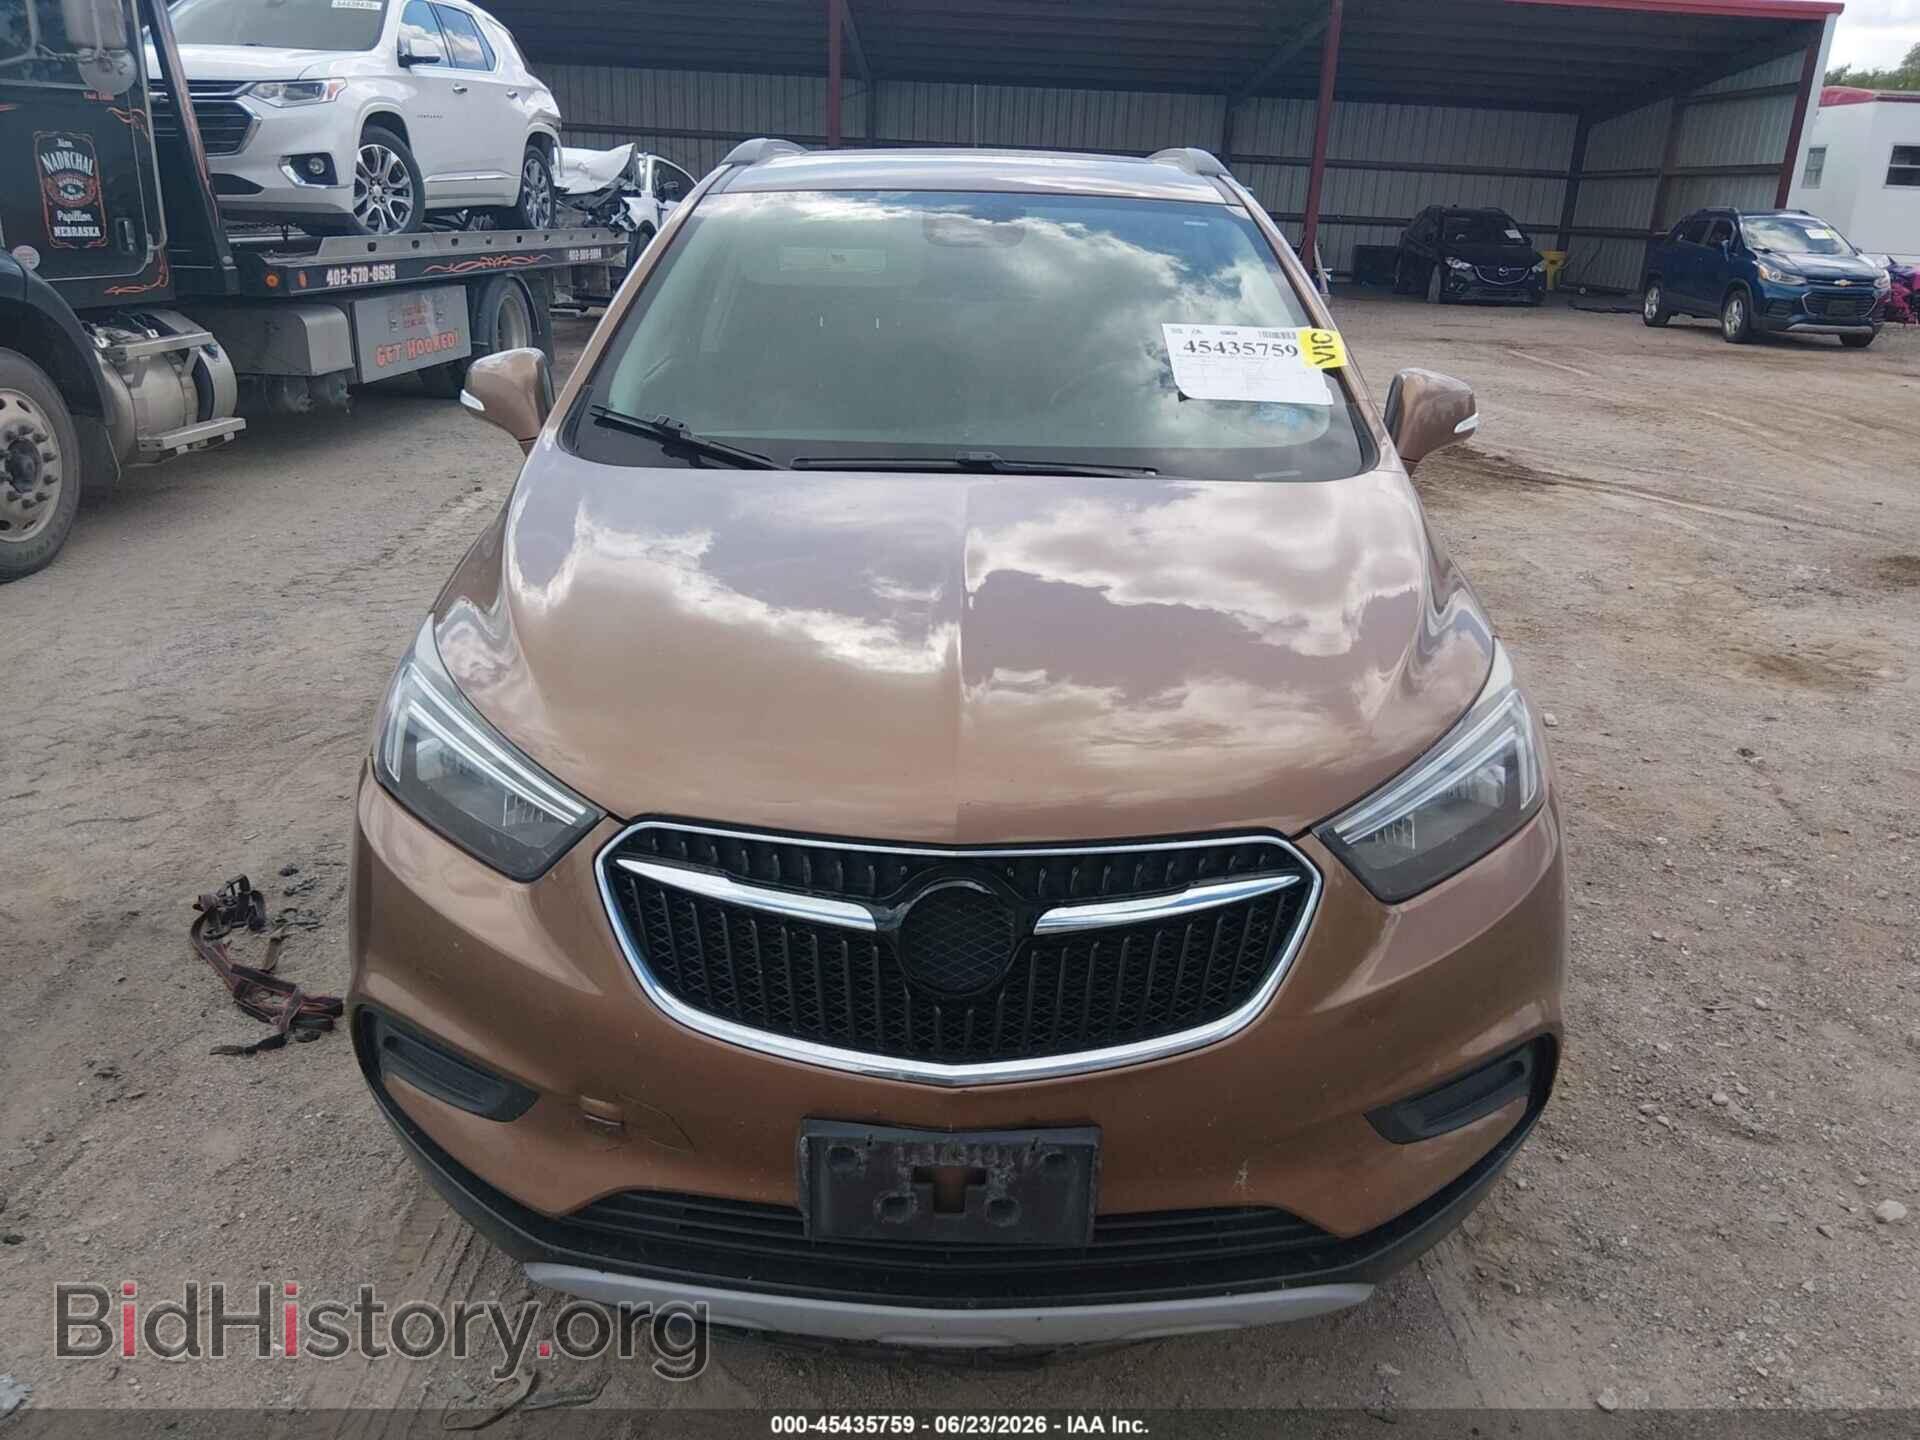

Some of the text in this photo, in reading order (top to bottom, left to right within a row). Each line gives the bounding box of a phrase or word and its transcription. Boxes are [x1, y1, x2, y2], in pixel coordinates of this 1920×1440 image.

[54, 226, 102, 237] NEBRASKA
[1183, 339, 1299, 357] 45435759
[1310, 331, 1336, 365] VIC
